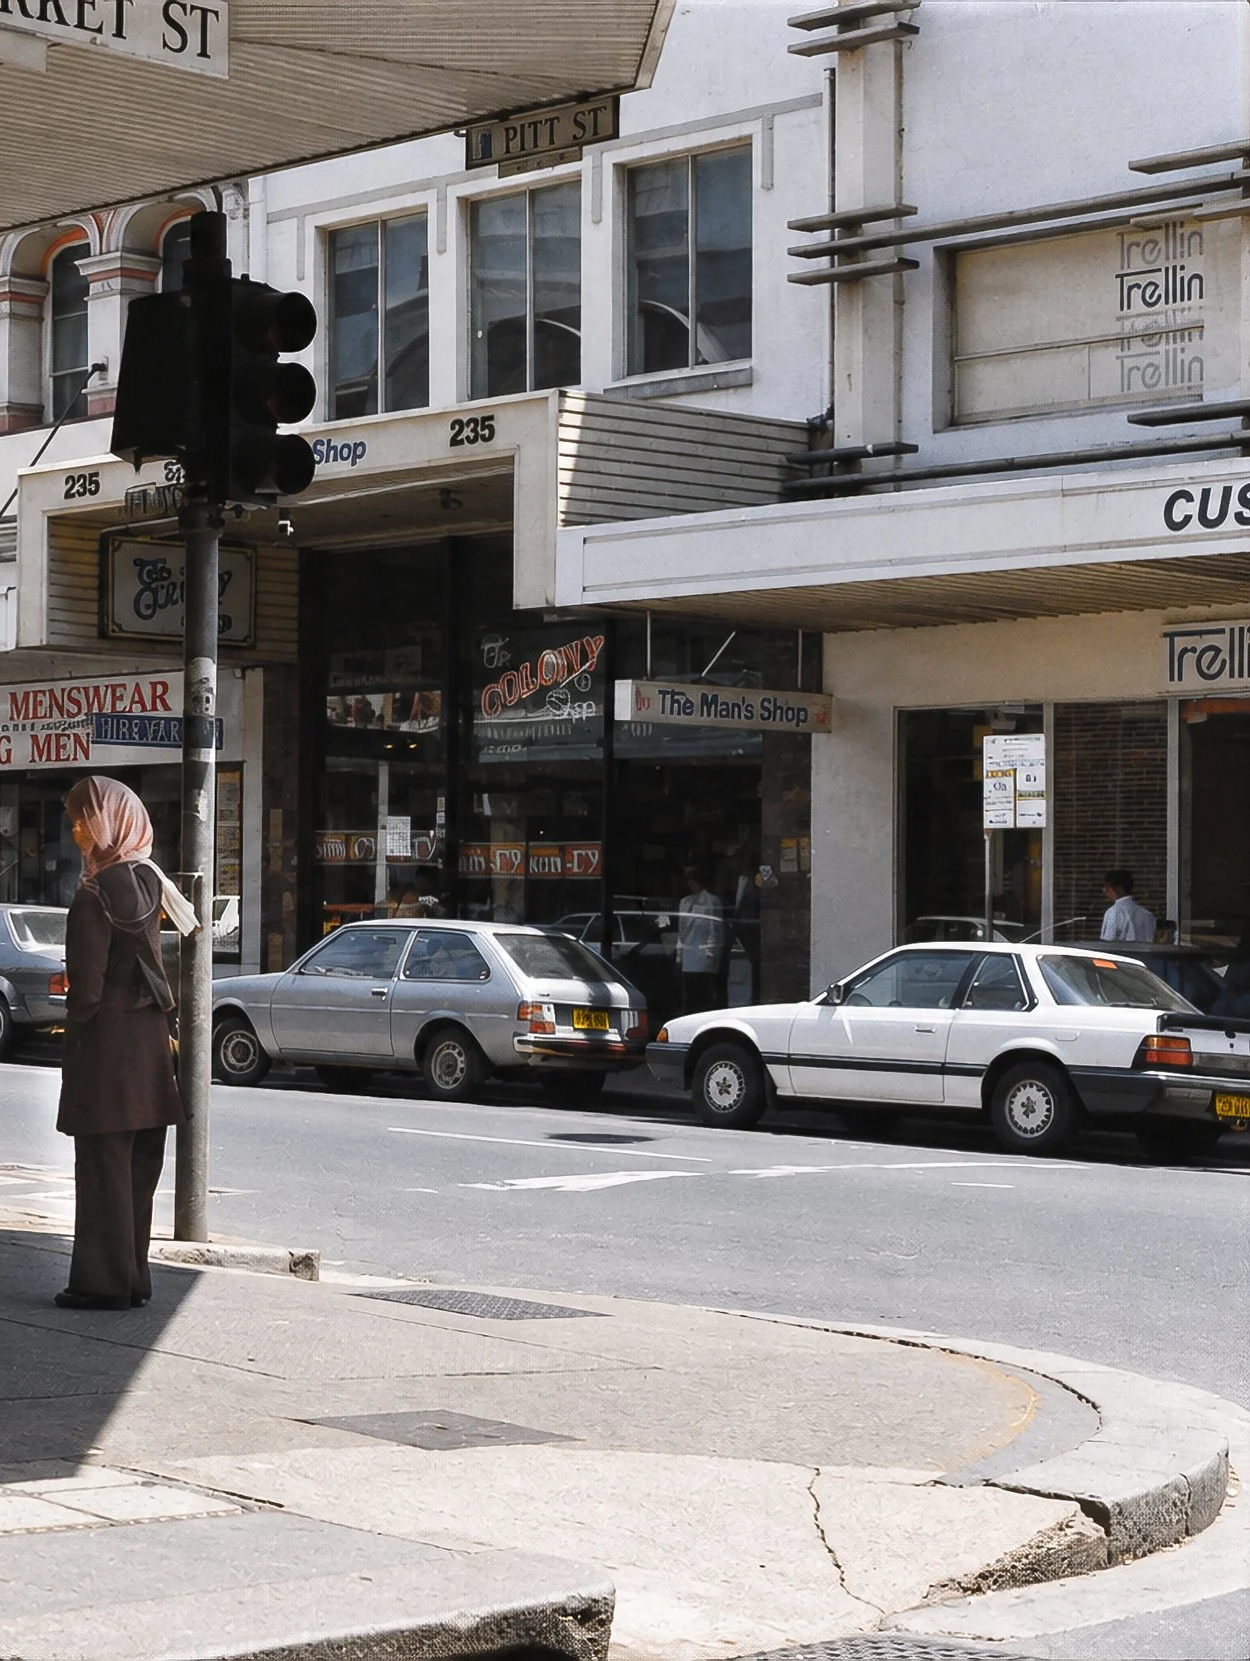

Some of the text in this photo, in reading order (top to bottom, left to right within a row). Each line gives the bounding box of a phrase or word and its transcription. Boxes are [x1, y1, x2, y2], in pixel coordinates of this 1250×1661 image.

[161, 1, 220, 59] ST
[503, 105, 608, 154] PITT ST
[1114, 264, 1205, 312] Trellin
[1115, 346, 1205, 393] Trellin
[449, 414, 495, 448] 235
[312, 438, 367, 467] Shop
[64, 471, 100, 500] 235
[481, 635, 604, 718] COLONY
[8, 680, 171, 720] MENSWEAR
[658, 689, 808, 727] The Man's Shop
[29, 732, 92, 764] MEN
